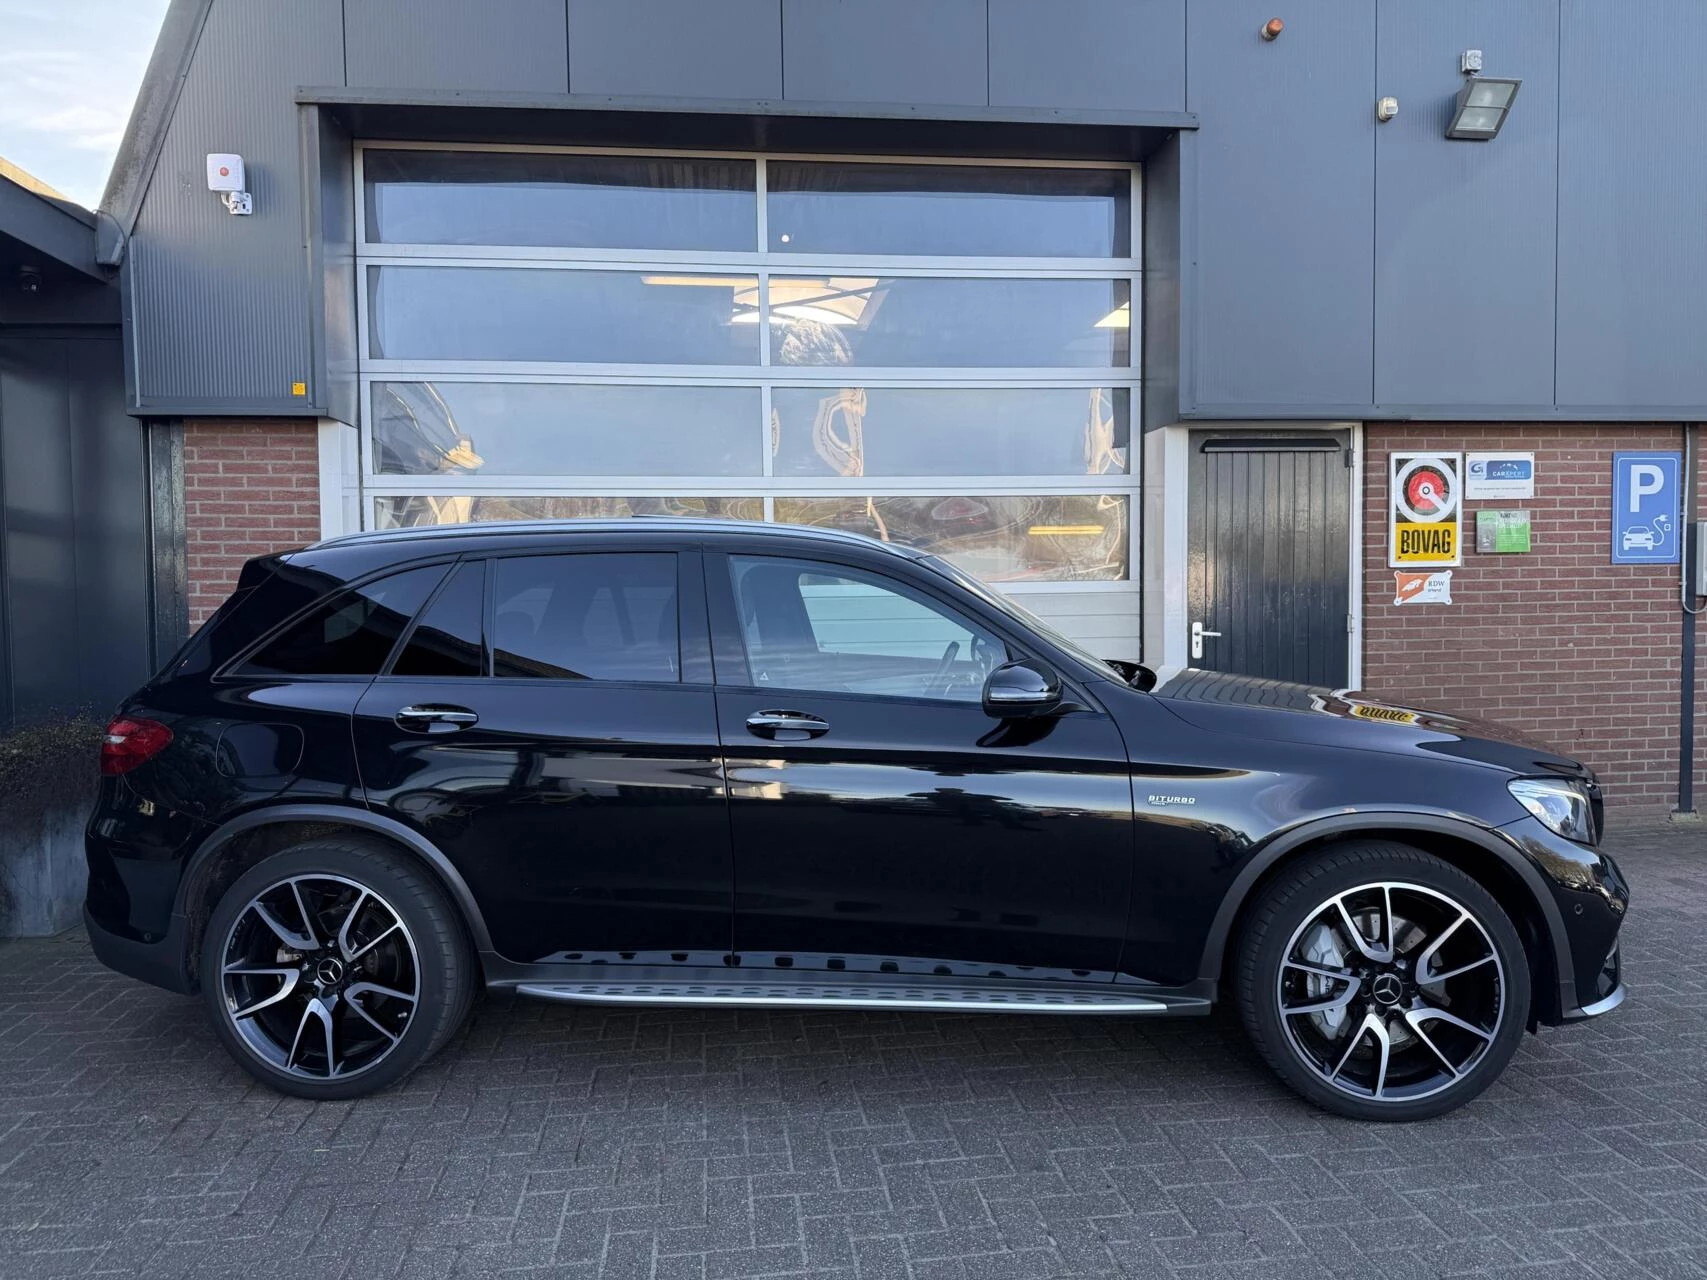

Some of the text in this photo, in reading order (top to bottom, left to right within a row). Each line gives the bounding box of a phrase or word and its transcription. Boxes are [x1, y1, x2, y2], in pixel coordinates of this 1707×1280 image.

[1629, 464, 1665, 513] P
[1400, 529, 1451, 554] BOVAG
[1148, 795, 1196, 804] BITURBO
